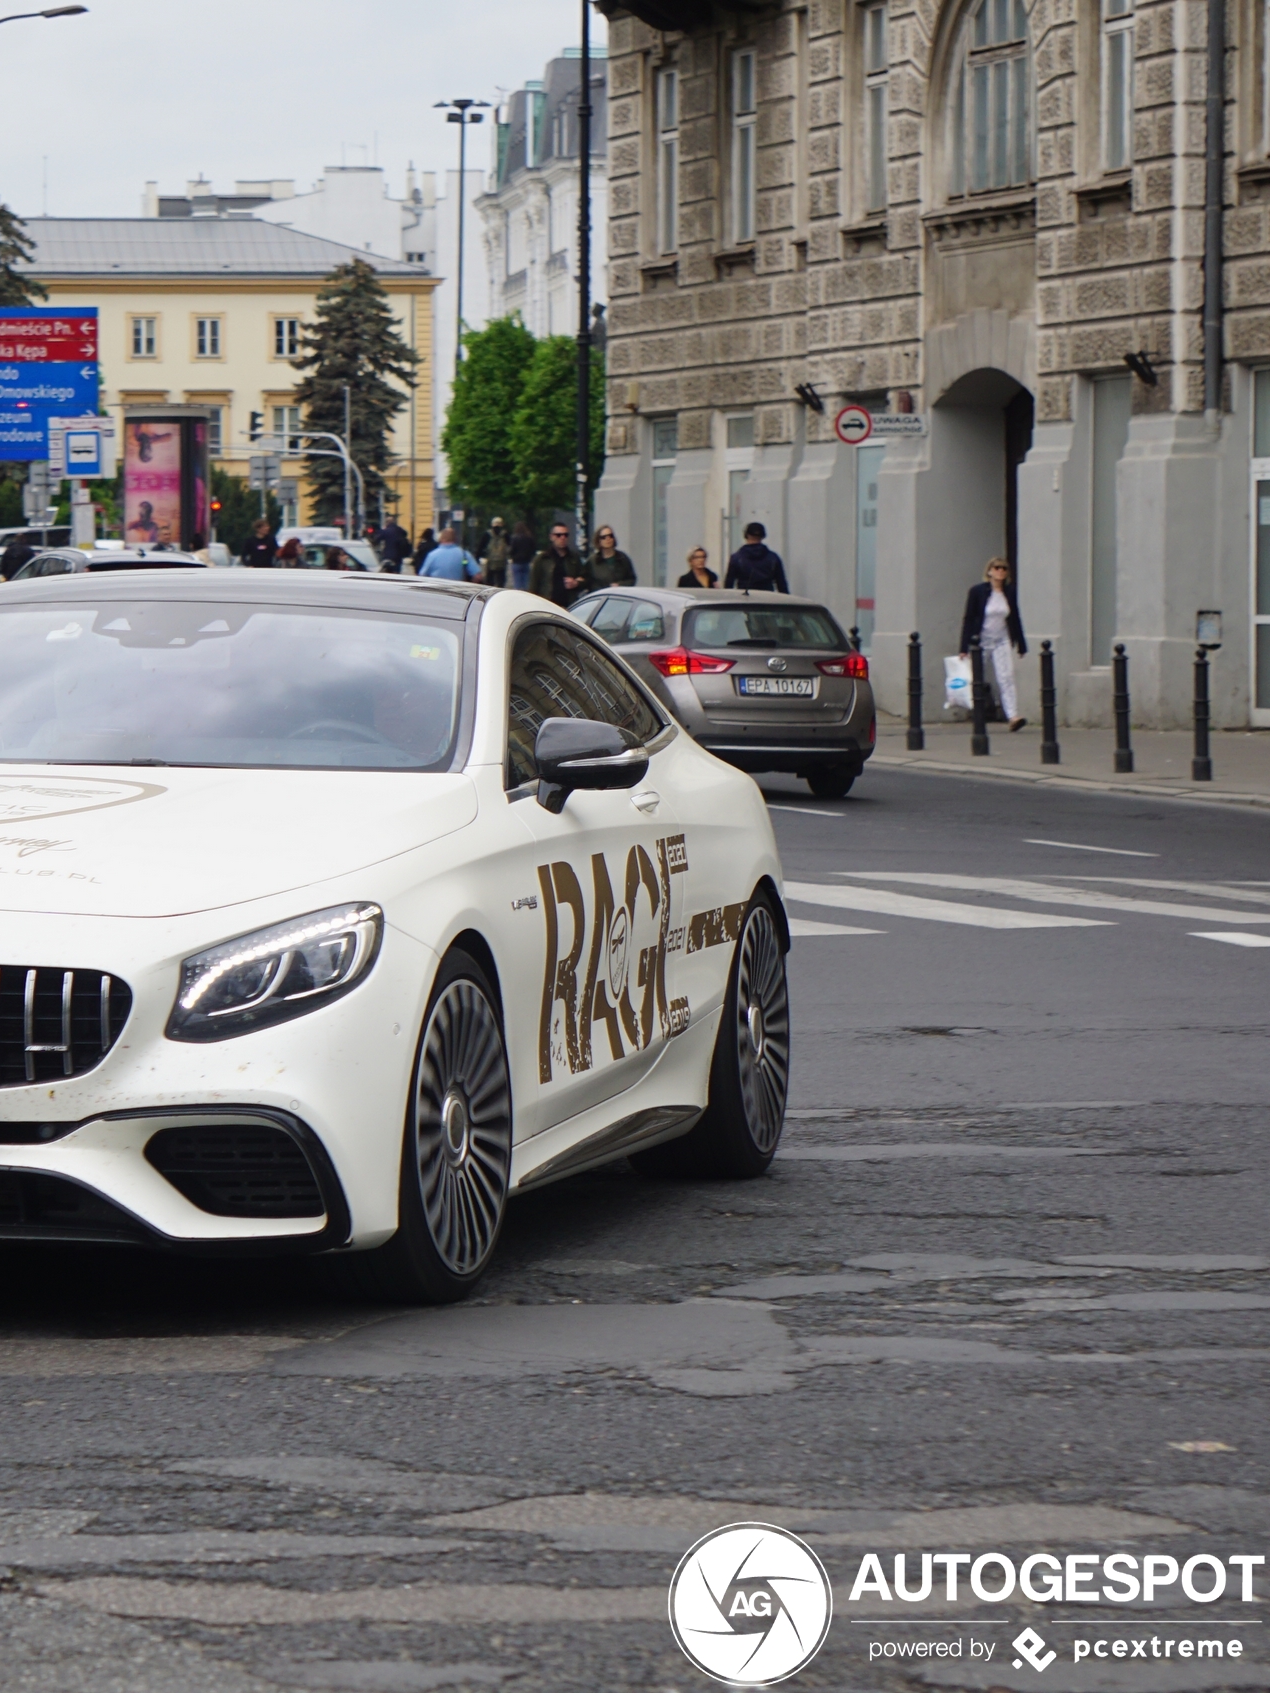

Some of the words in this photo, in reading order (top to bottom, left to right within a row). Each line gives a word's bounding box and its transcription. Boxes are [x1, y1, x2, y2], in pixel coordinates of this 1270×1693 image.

[54, 322, 75, 336] Pn.
[16, 345, 48, 360] Kępa
[747, 679, 770, 692] EPA
[775, 680, 810, 693] 10167
